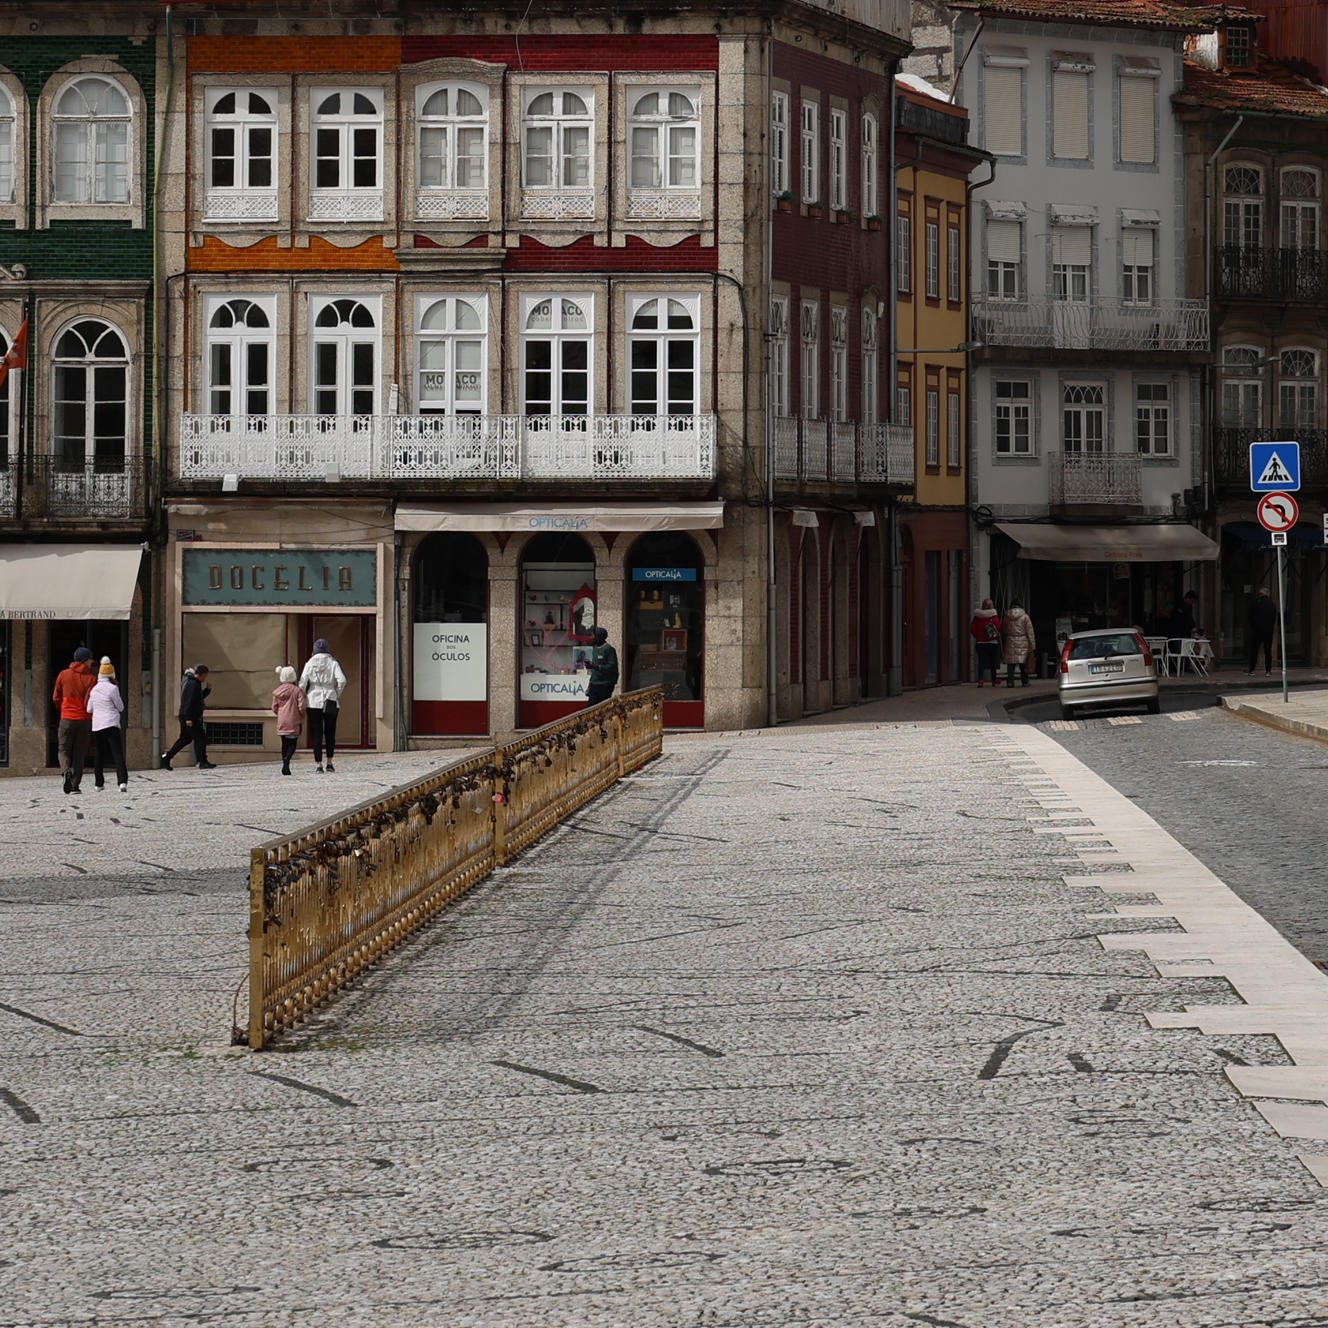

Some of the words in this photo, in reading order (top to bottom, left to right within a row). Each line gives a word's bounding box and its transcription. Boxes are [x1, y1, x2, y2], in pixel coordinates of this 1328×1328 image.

[532, 305, 583, 316] MOACO
[426, 374, 477, 385] MOACO
[8, 610, 56, 619] BERTRAND
[432, 634, 470, 643] OFICINA
